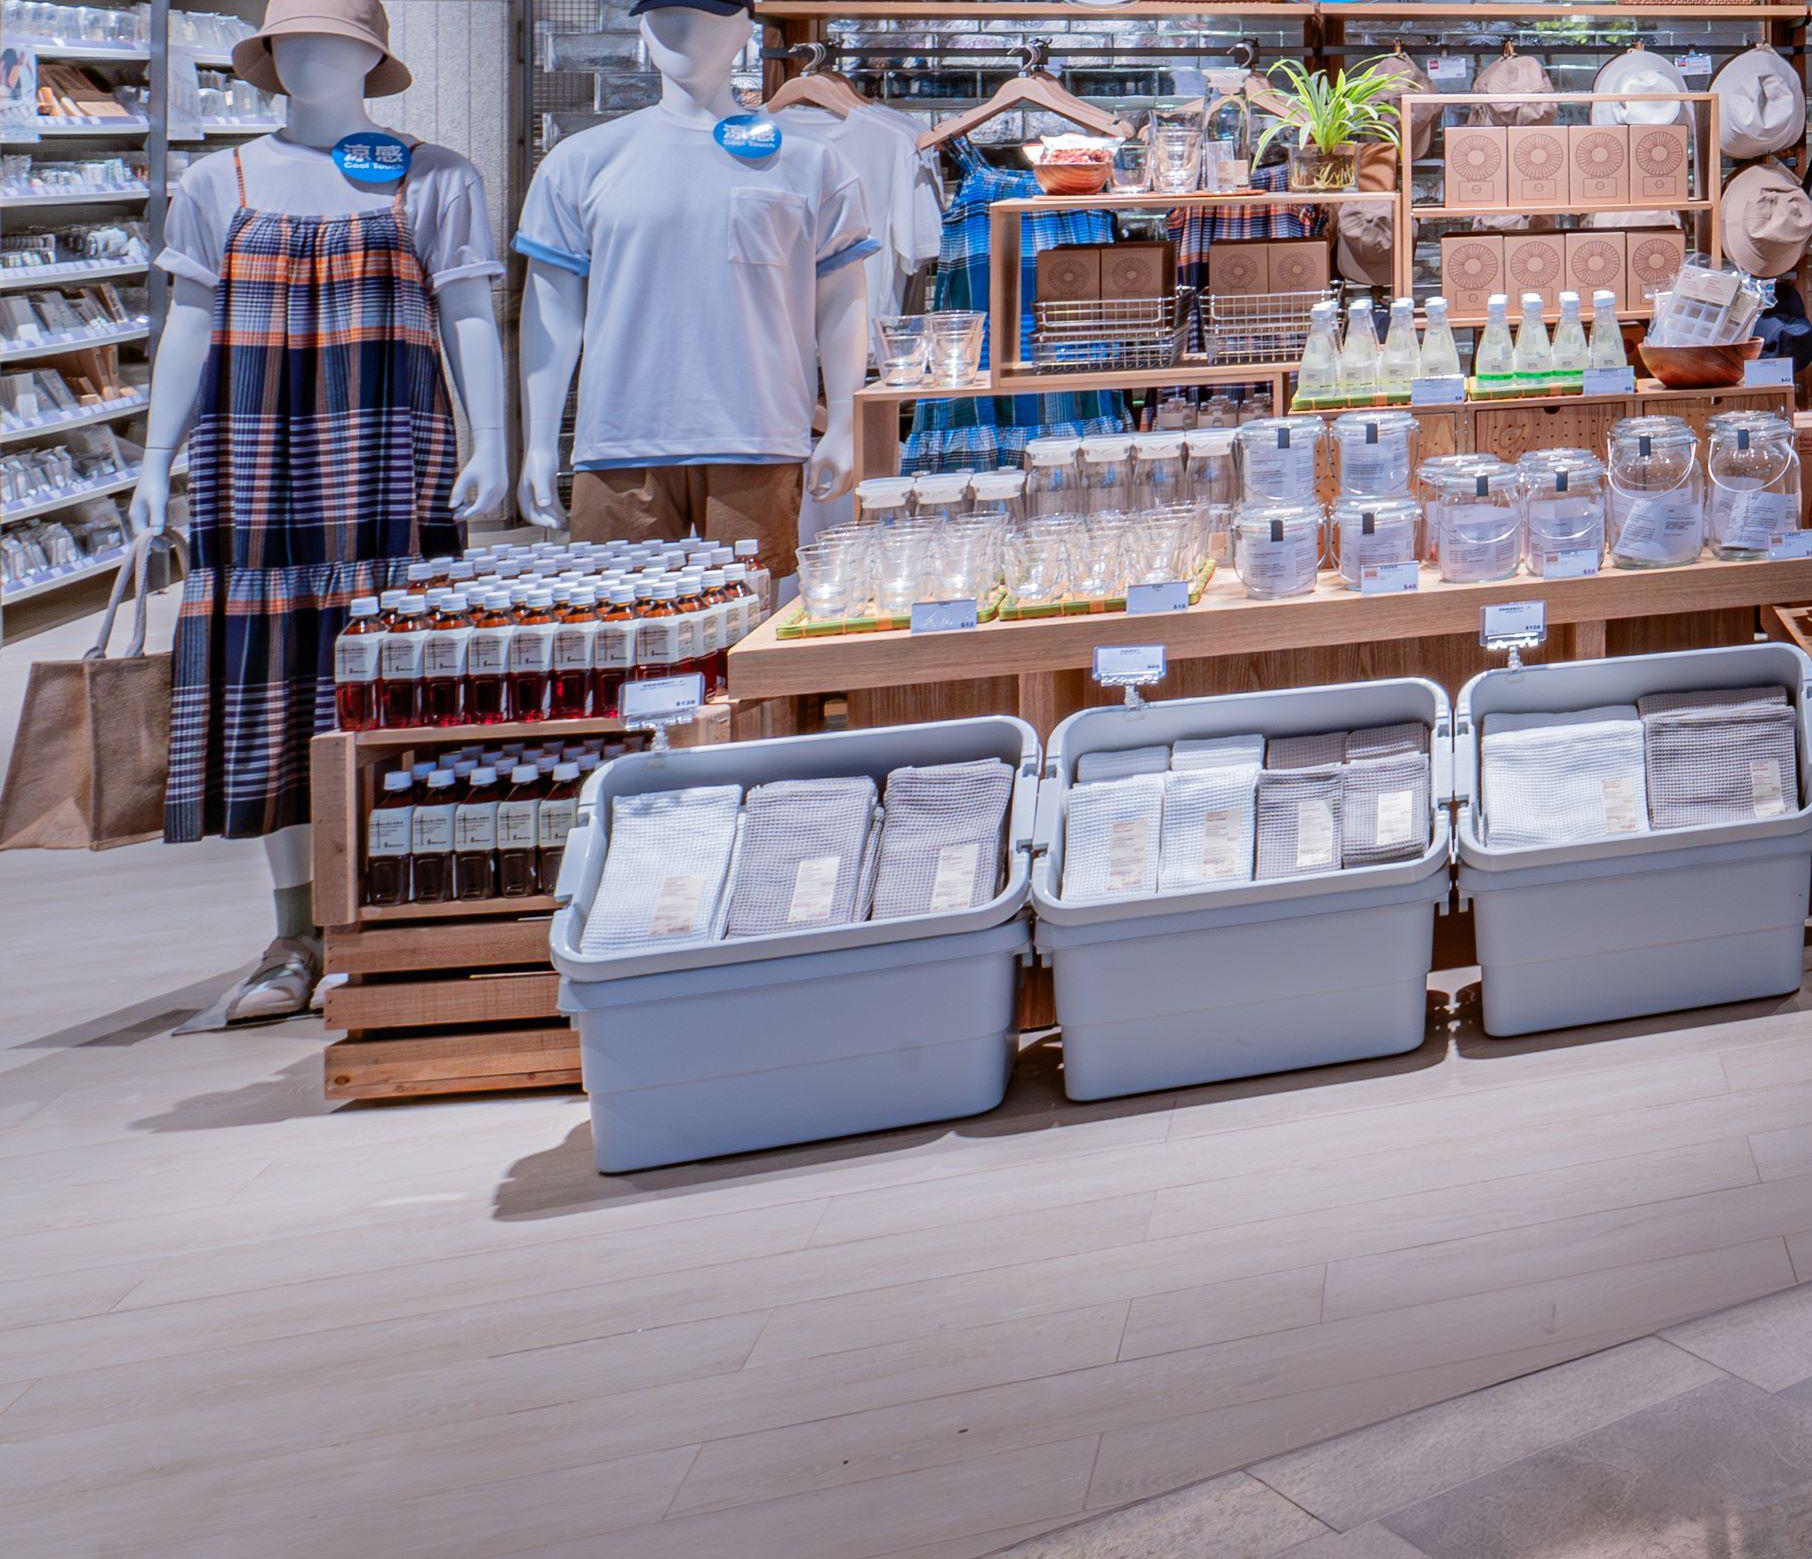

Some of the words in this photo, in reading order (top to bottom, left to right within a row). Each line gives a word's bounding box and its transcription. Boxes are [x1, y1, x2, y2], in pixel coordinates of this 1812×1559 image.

[748, 140, 776, 149] Touch
[343, 144, 403, 162] 涼感
[343, 162, 370, 170] Cool
[372, 162, 404, 171] Touch
